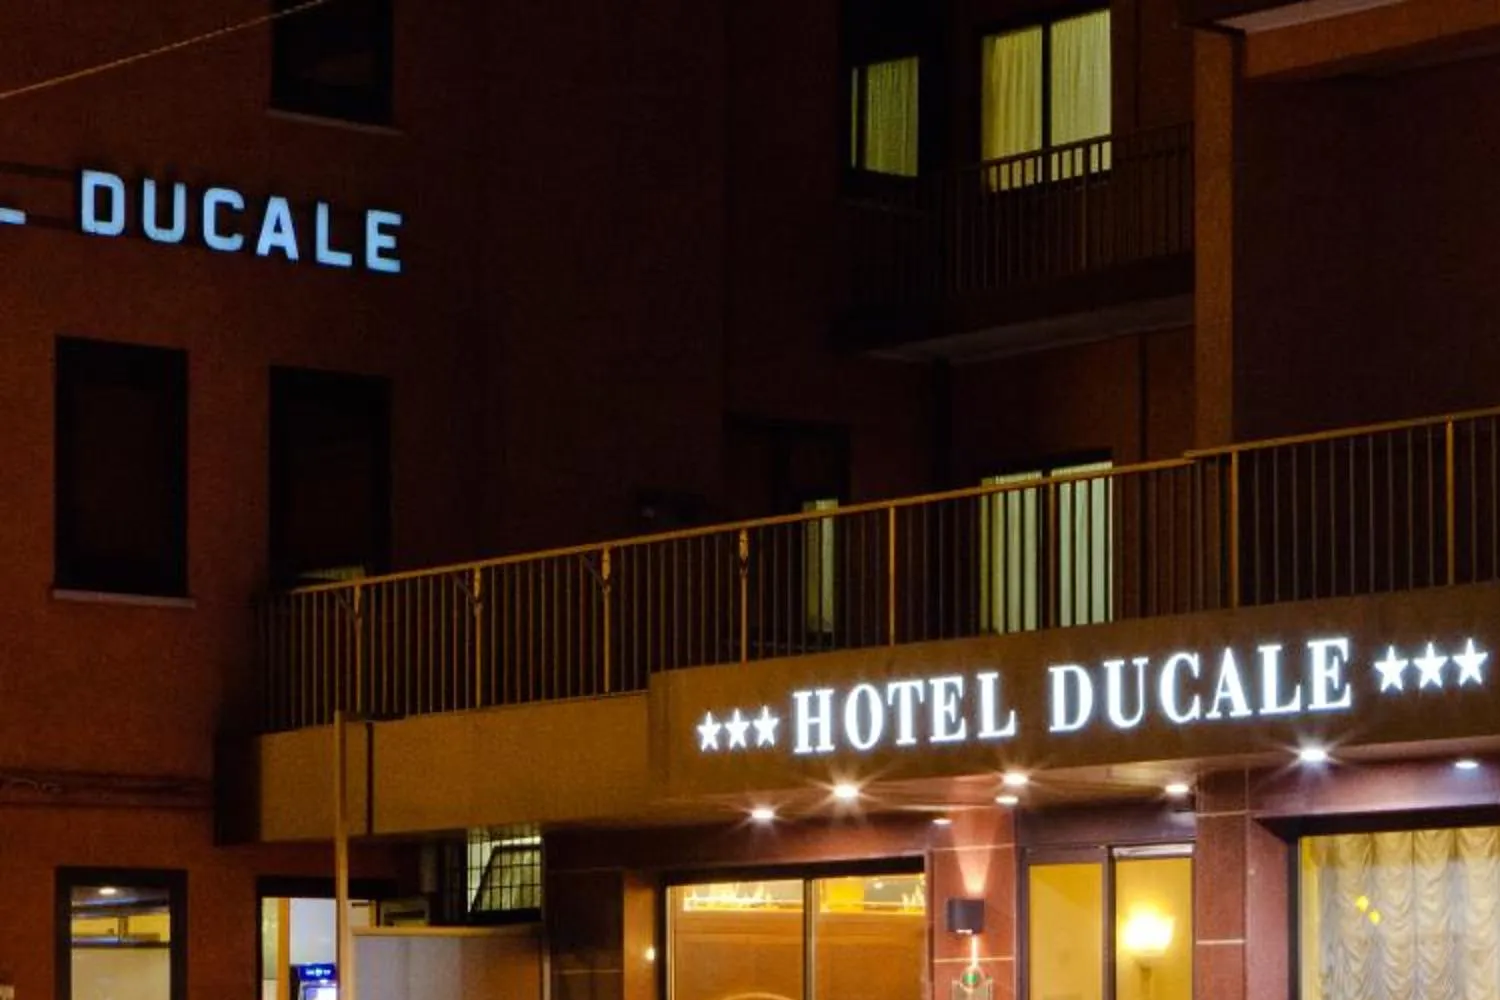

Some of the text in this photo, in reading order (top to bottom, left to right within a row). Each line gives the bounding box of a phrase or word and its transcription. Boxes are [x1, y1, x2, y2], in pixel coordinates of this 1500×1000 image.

[81, 169, 402, 273] DUCALE
[792, 637, 1353, 754] HOTEL DUCALE
